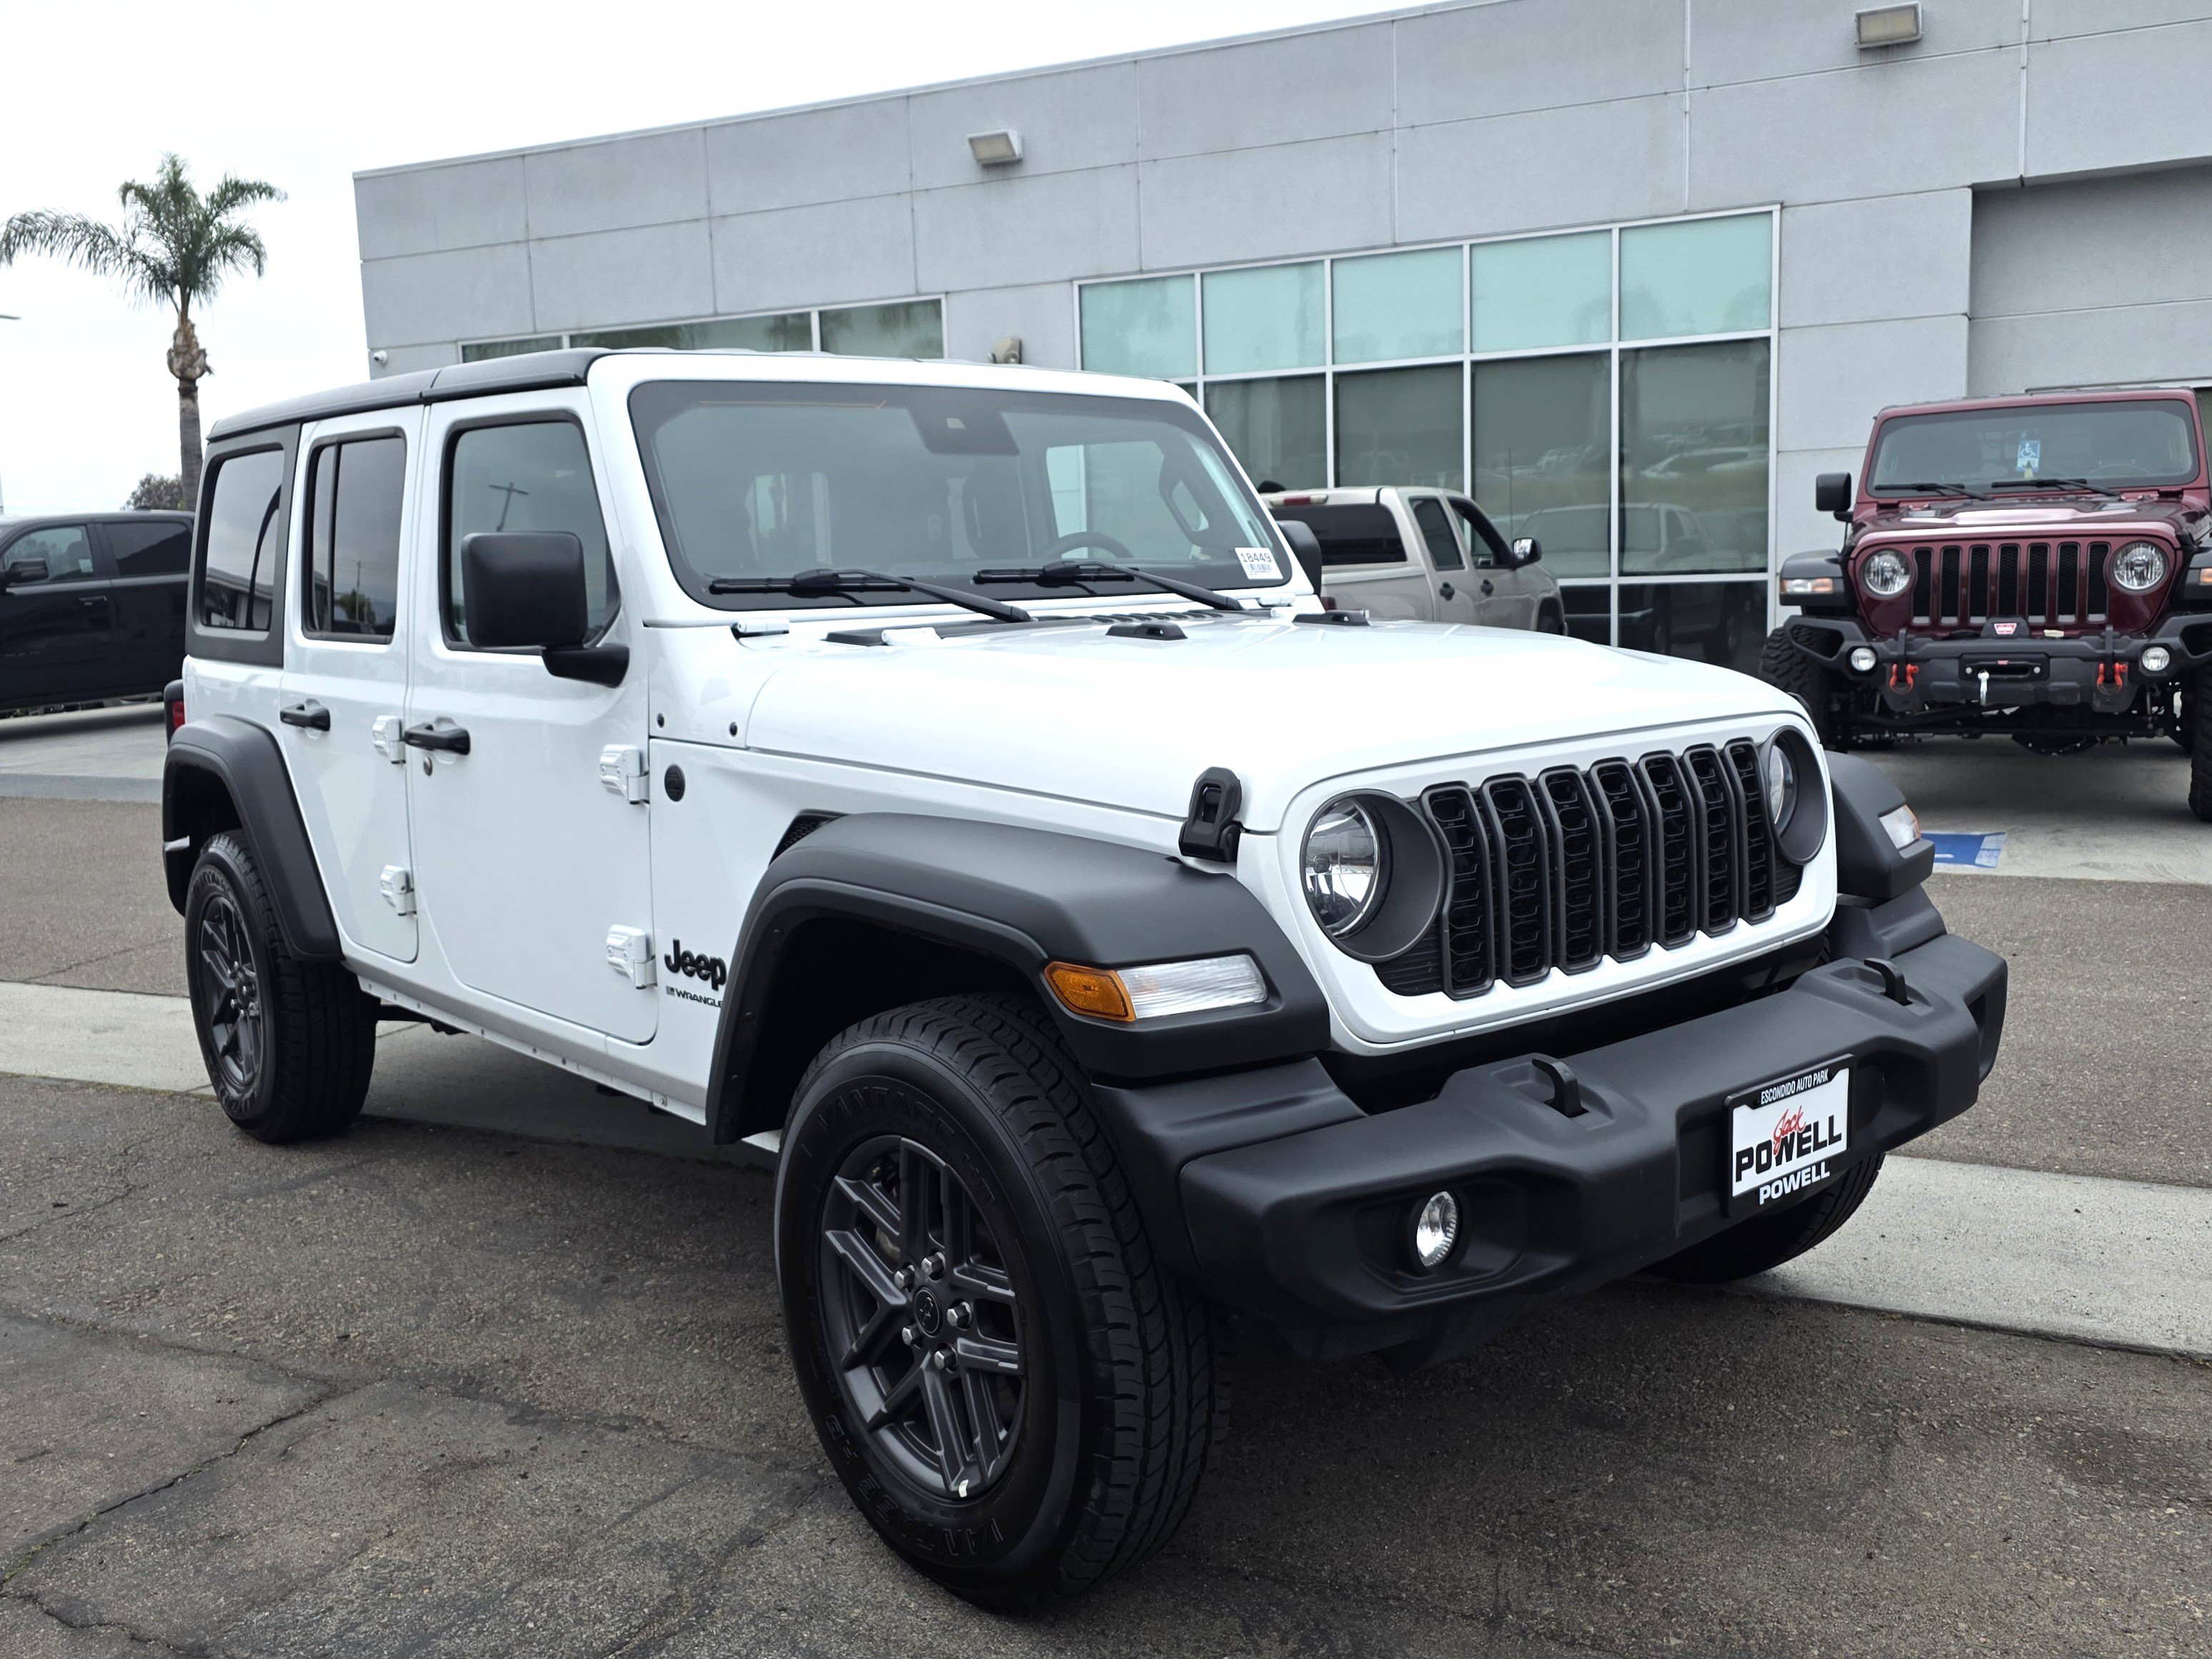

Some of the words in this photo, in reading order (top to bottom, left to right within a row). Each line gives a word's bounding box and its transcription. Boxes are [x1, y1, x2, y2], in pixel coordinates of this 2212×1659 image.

[1241, 553, 1272, 562] 18449
[664, 938, 727, 991] Jeep
[1761, 1081, 1796, 1105] ESCONDIDO
[1796, 1075, 1812, 1091] AUTO
[1813, 1068, 1829, 1086] PARK
[1736, 1114, 1842, 1183] POWELL
[1774, 1106, 1807, 1156] Jack
[1759, 1161, 1830, 1205] POWELL
